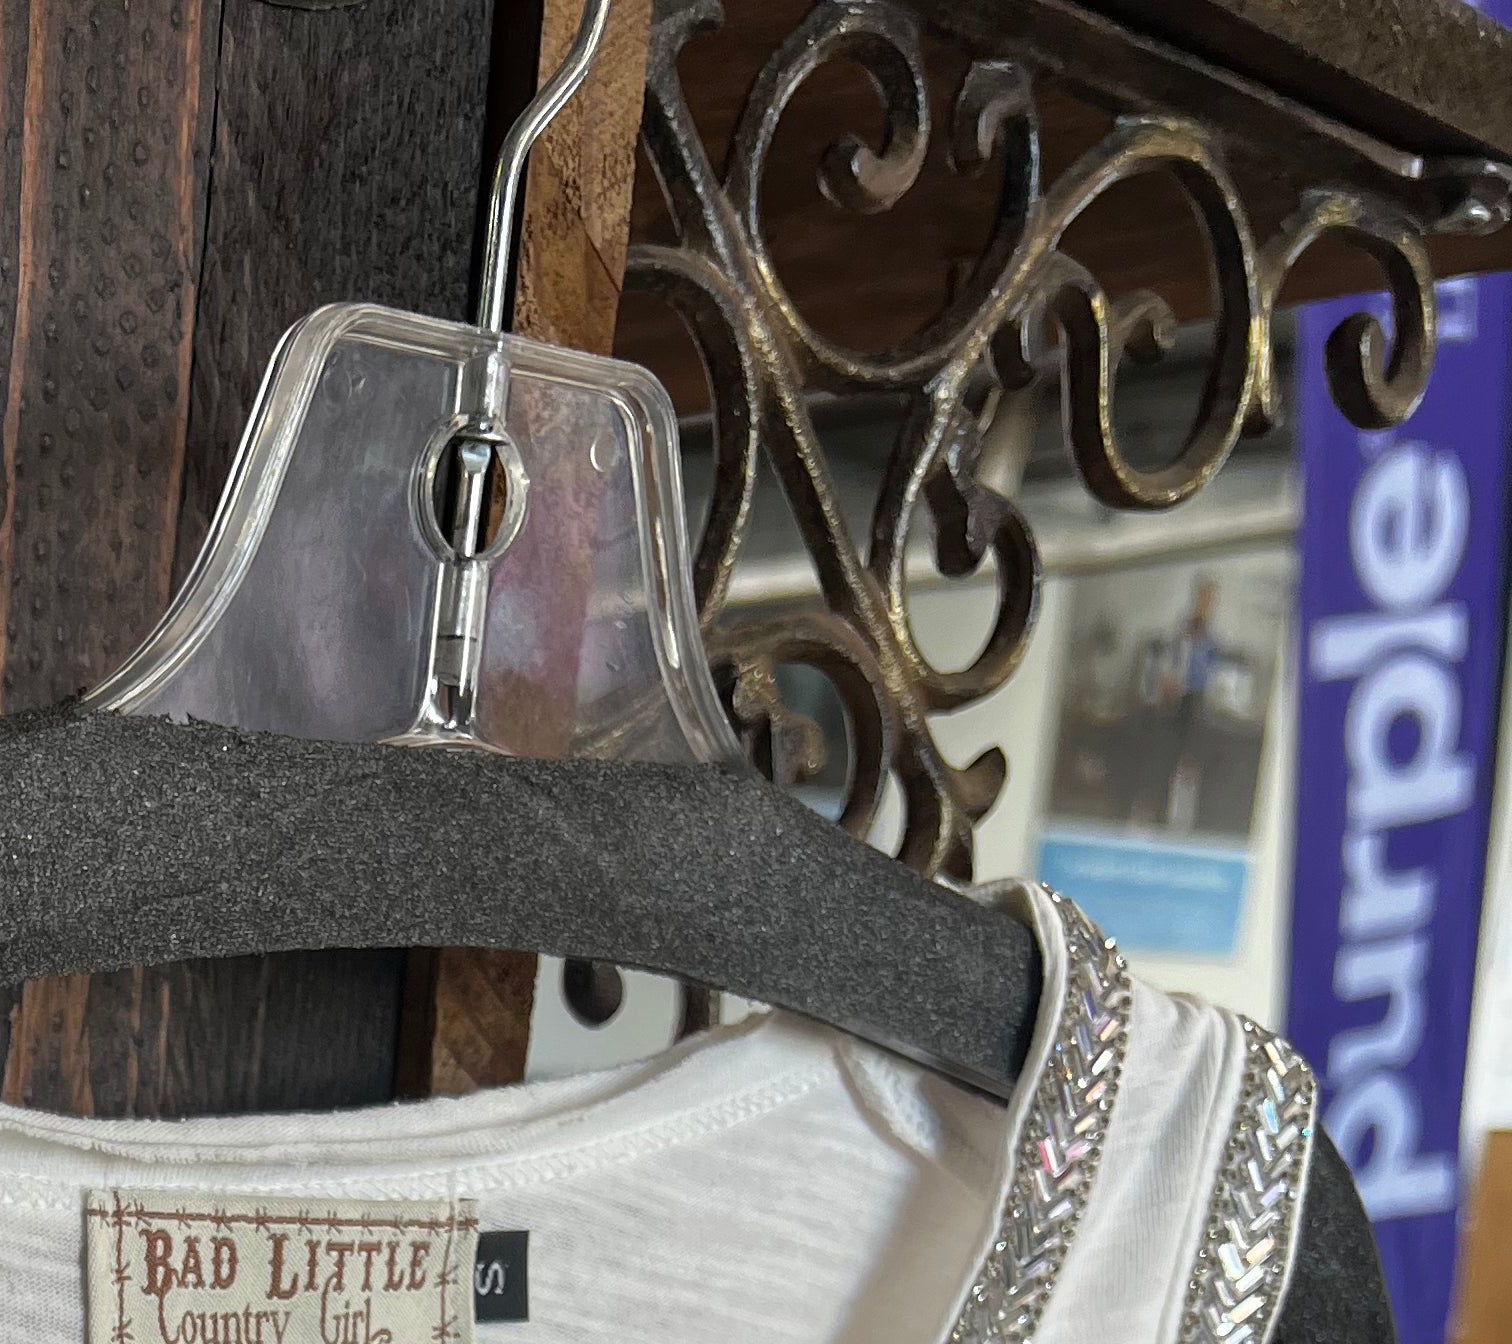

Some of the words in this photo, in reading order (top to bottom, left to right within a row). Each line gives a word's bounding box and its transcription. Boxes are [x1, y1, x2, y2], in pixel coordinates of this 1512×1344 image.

[1305, 438, 1477, 1222] purple
[139, 1229, 239, 1297] BAD
[265, 1233, 431, 1300] LITTLE
[474, 1261, 505, 1296] S
